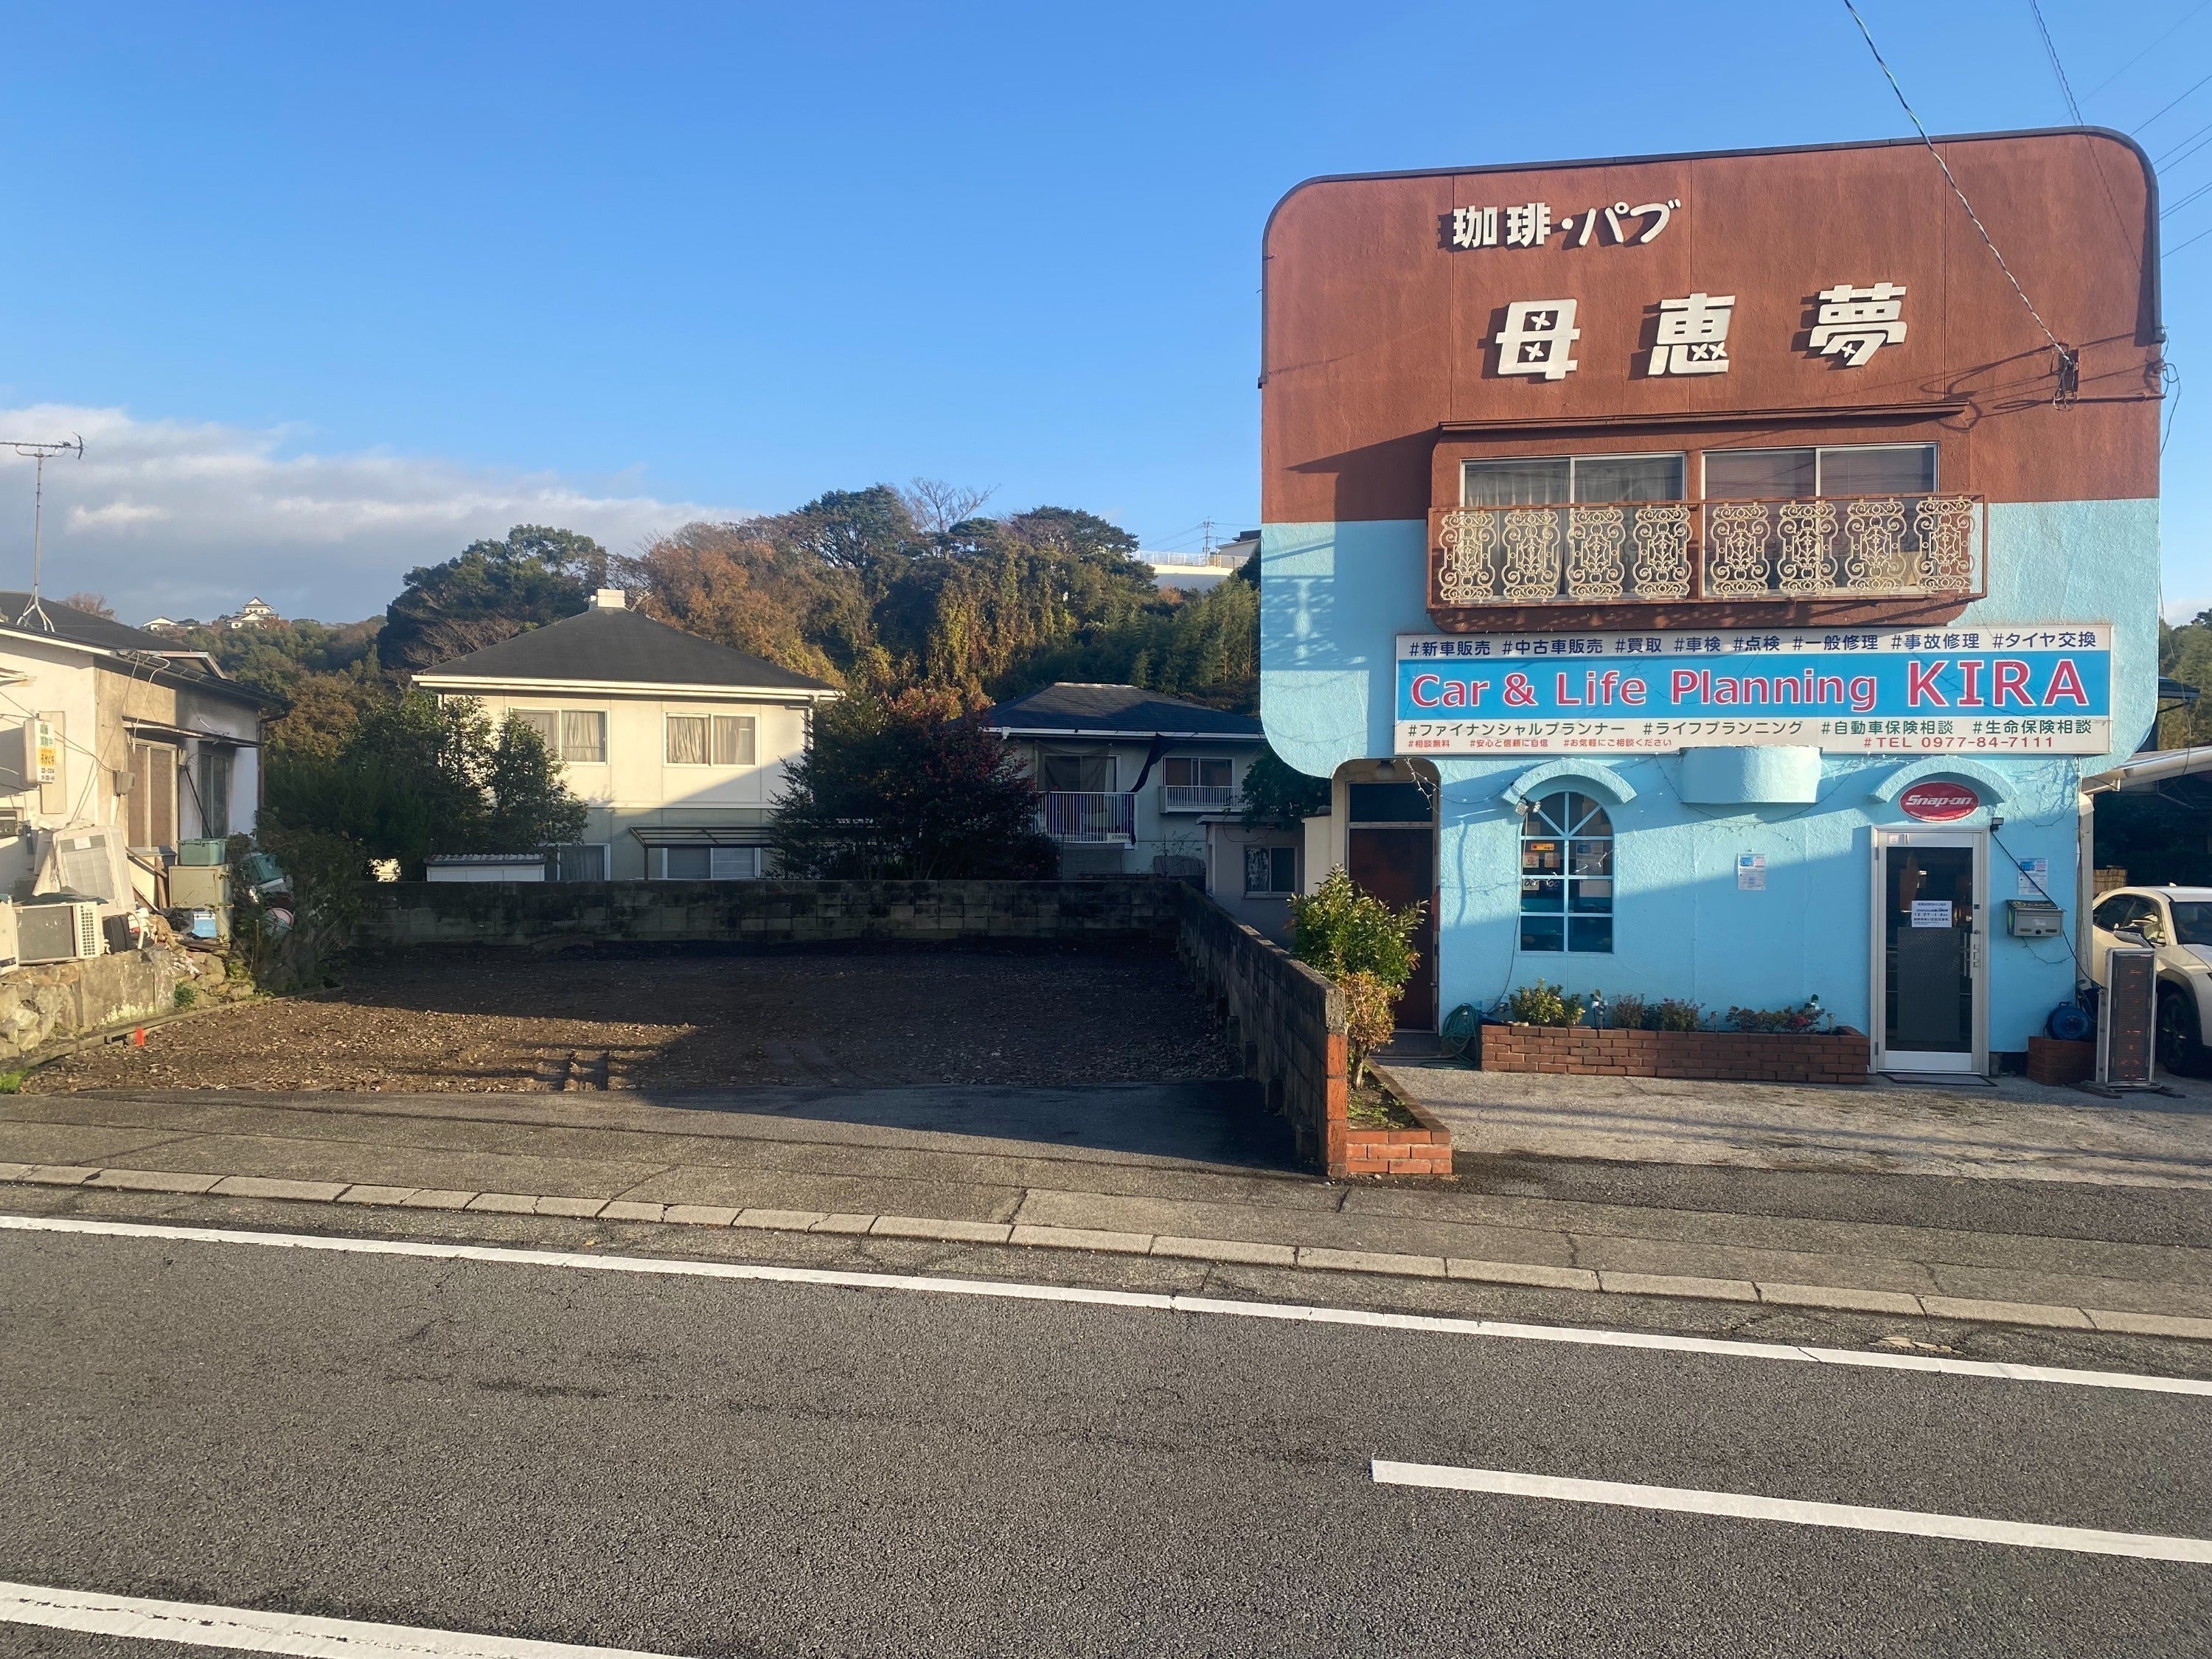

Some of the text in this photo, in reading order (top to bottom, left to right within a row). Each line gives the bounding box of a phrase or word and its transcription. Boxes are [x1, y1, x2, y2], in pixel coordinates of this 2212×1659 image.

[1453, 198, 1682, 248] 珈琲・パブ
[1495, 282, 1908, 380] 母恵夢
[1409, 631, 2096, 656] #新車販売 #中古車販売 #買取 #車検 #点検 #一般修理 #事故修理 #タイヤ交換
[1411, 658, 2090, 713] Car & Life Planning KIRA
[1408, 720, 2092, 737] #ファイナンシャルプランナー #ライフプランニング #自動車保険相談 #生命保険相談
[1408, 738, 1672, 748] #相談無料 #安心と信頼に自信 #お気軽にご相談ください
[1864, 737, 2053, 748] #TEL 0977-84-7111
[1905, 794, 1972, 807] Snap-on
